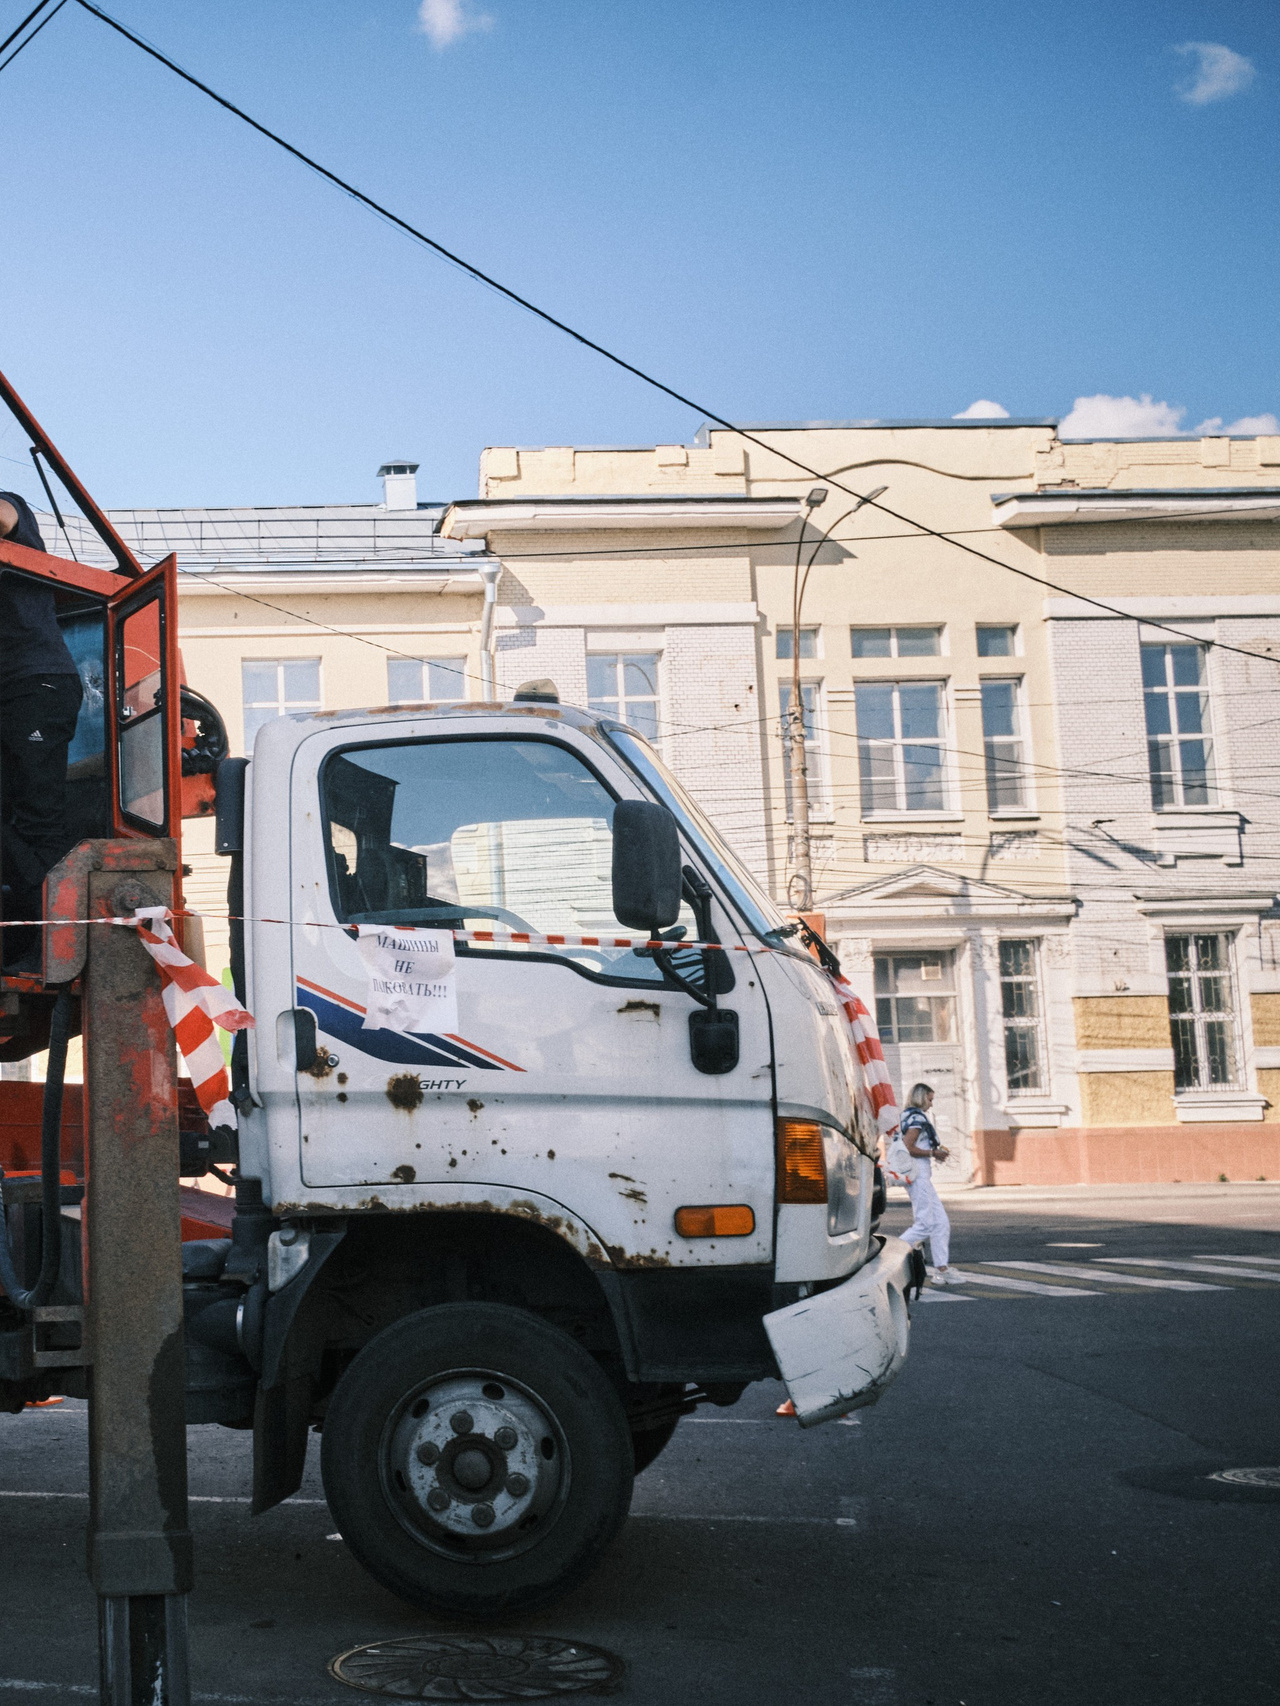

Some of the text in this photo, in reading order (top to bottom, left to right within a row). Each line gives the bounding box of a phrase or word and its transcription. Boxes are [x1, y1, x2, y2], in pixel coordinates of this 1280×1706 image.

[376, 935, 439, 953] МАШИНЫ
[394, 960, 415, 974] НЕ
[417, 1079, 467, 1090] GHTY
